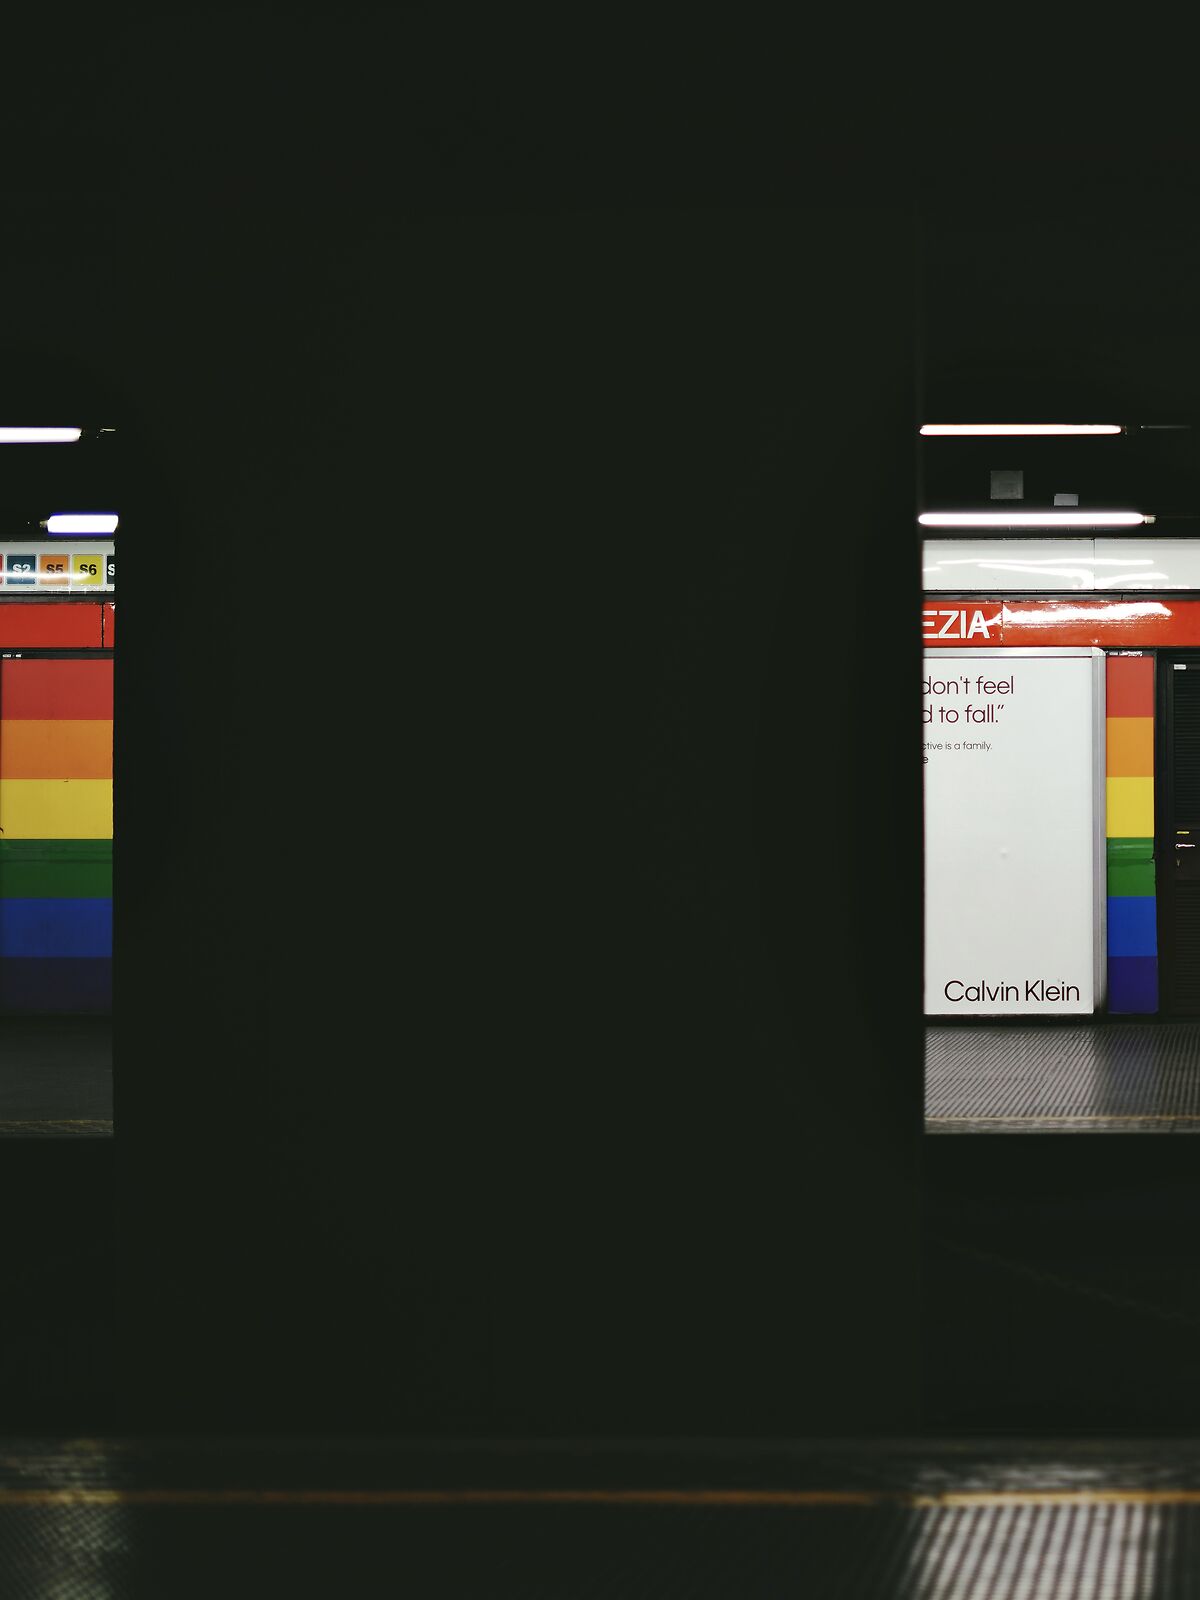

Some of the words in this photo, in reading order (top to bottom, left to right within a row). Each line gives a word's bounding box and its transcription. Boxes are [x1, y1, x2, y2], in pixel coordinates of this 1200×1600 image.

[12, 563, 31, 575] S2
[46, 563, 64, 575] S5
[79, 563, 97, 576] S6
[922, 610, 990, 639] EZIA
[922, 675, 970, 695] don't
[975, 675, 1014, 695] feel
[938, 706, 959, 724] to
[945, 741, 952, 750] is
[963, 741, 992, 752] family.
[944, 980, 1019, 1002] Calvin
[1025, 980, 1080, 1002] Klein
